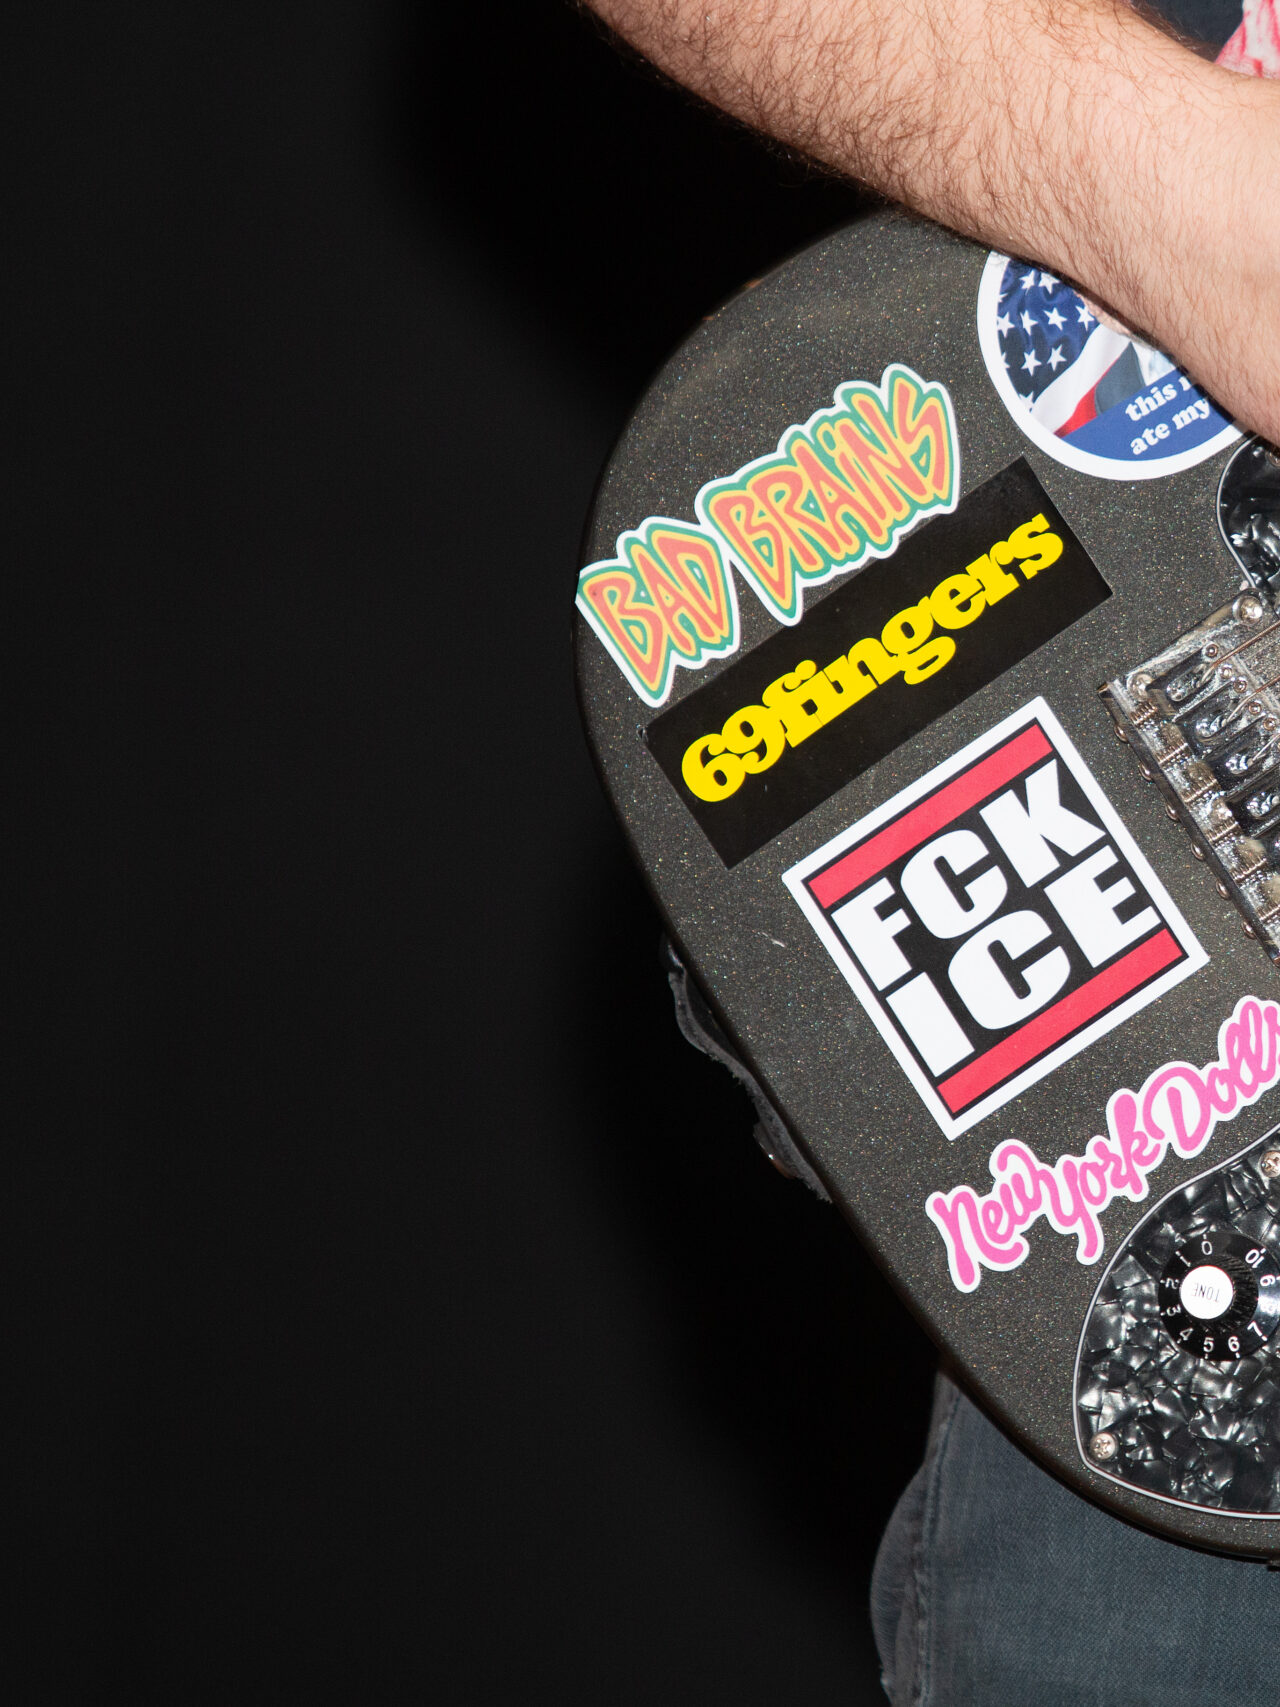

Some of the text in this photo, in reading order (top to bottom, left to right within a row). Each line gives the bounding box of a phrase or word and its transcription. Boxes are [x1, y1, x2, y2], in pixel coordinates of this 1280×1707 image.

[1125, 384, 1177, 421] this
[1130, 398, 1210, 455] ate my
[581, 375, 951, 694] BAD BRAINS
[682, 513, 1063, 802] 69fingers
[831, 759, 1107, 993] FCK
[886, 846, 1163, 1078] ICE
[933, 1144, 1043, 1286] New
[1036, 1093, 1161, 1258] York
[1201, 1240, 1213, 1255] 0
[1245, 1248, 1265, 1268] 10
[1165, 1277, 1180, 1290] 2
[1259, 1274, 1276, 1287] 9
[1192, 1282, 1220, 1302] TONE
[1166, 1304, 1182, 1317] 3
[1179, 1327, 1194, 1341] 4
[1247, 1321, 1263, 1337] 7
[1203, 1337, 1214, 1352] 5
[1227, 1335, 1240, 1352] 6
